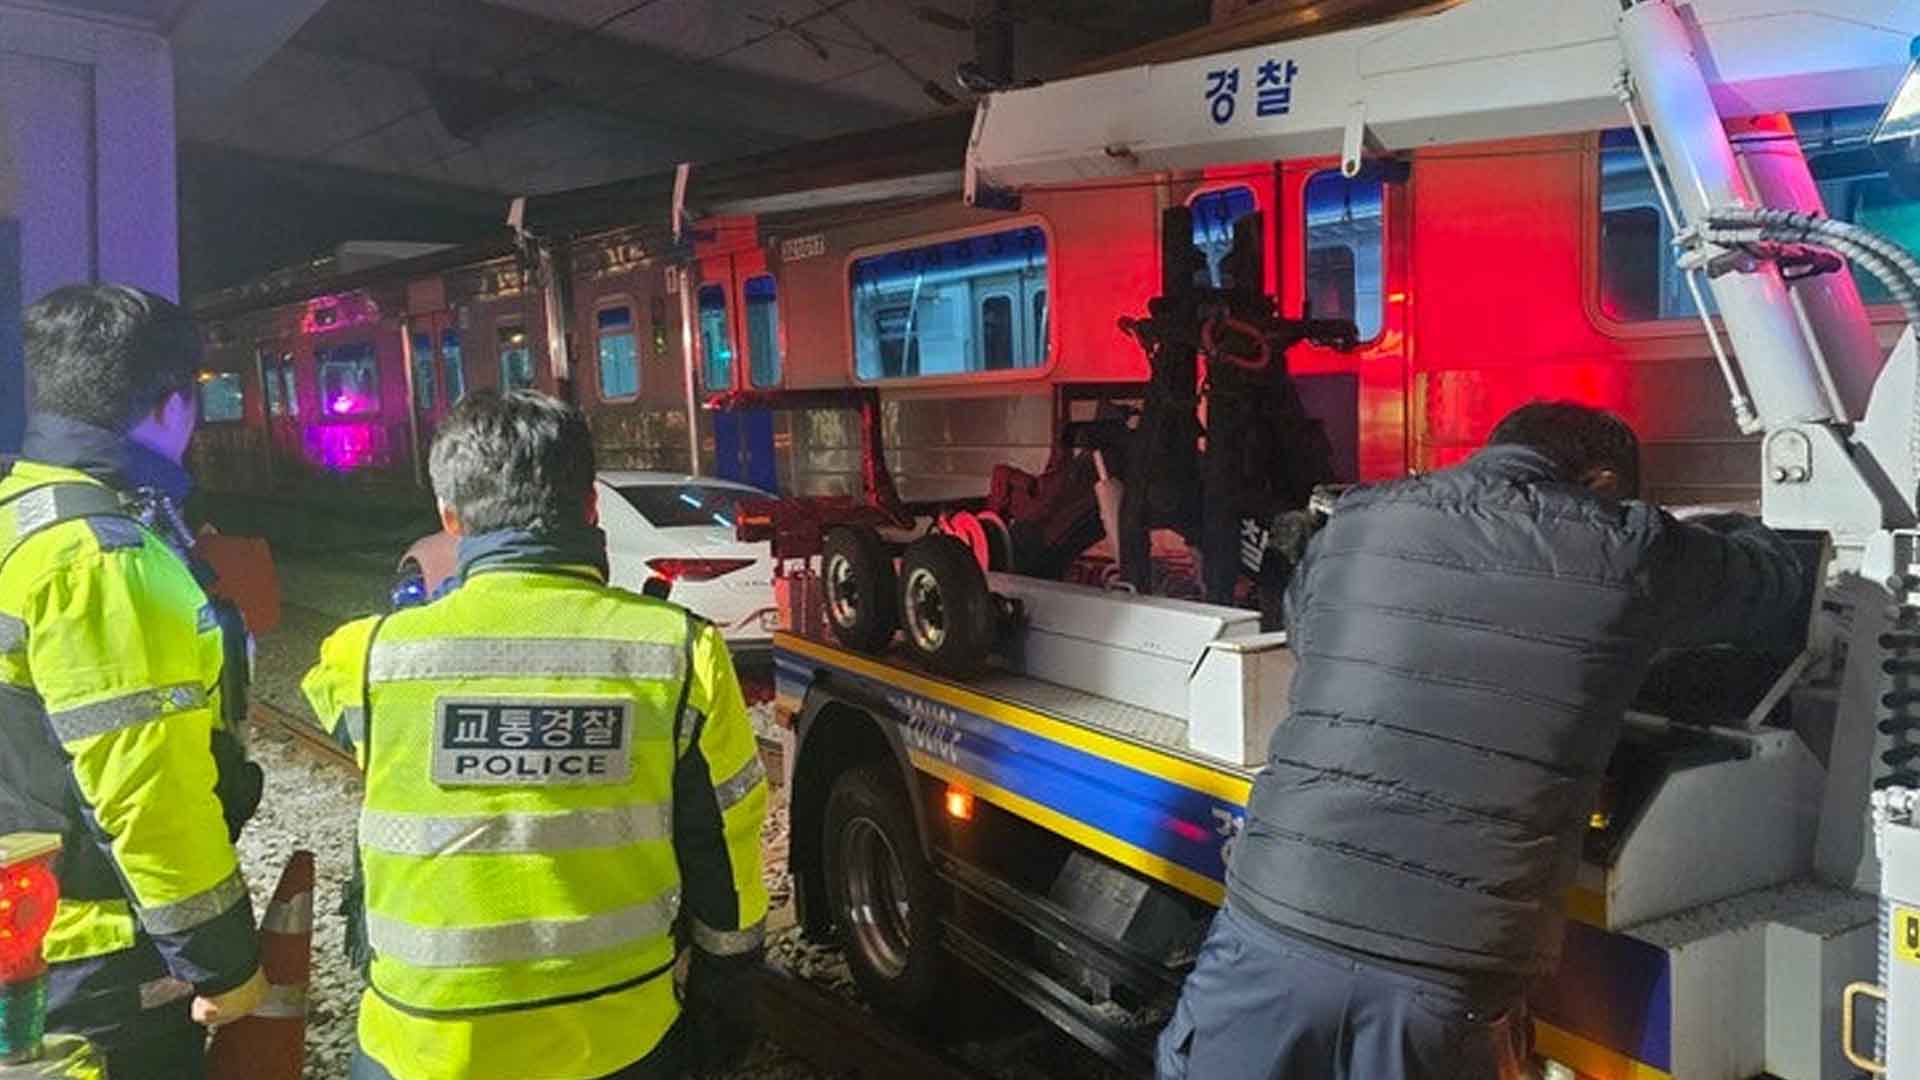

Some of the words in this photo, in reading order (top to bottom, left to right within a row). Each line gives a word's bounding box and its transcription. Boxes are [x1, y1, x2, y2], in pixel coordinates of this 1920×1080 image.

[1205, 59, 1298, 125] 경찰
[452, 707, 618, 748] 교통경찰
[455, 754, 608, 776] POLICE
